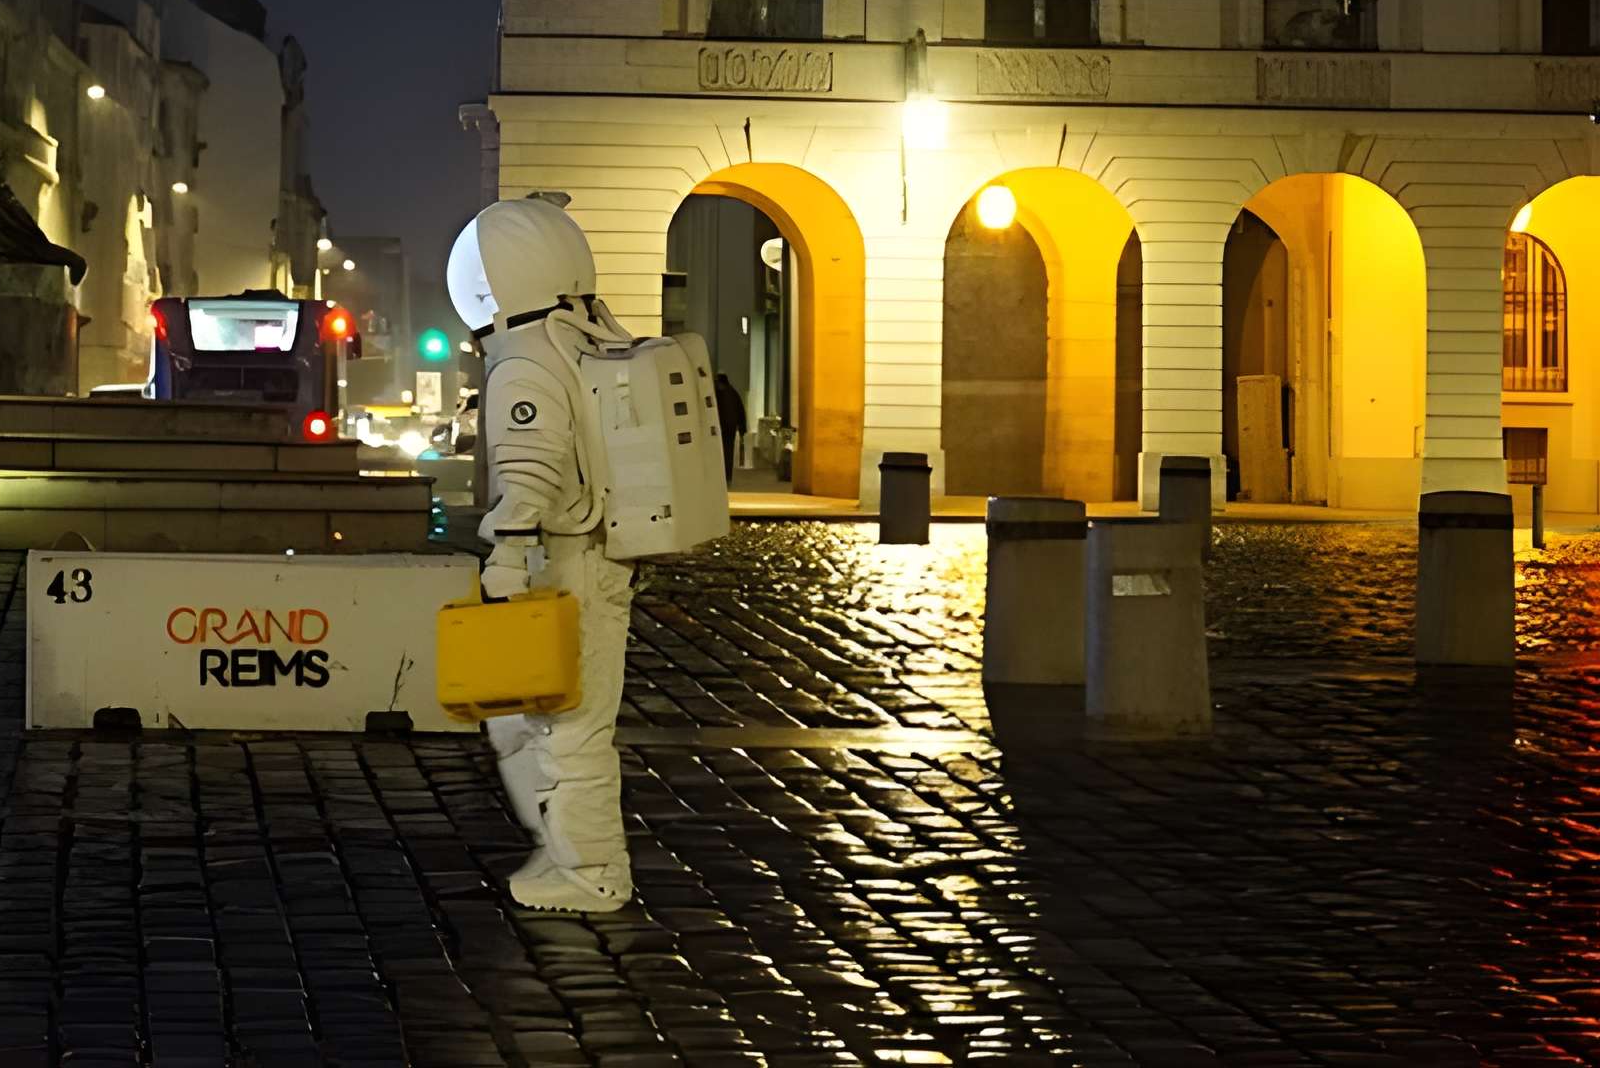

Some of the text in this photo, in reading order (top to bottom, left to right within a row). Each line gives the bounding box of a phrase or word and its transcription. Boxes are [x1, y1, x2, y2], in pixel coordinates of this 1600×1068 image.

[46, 568, 93, 604] 43
[166, 607, 329, 644] GRAND
[200, 648, 330, 688] REIMS
